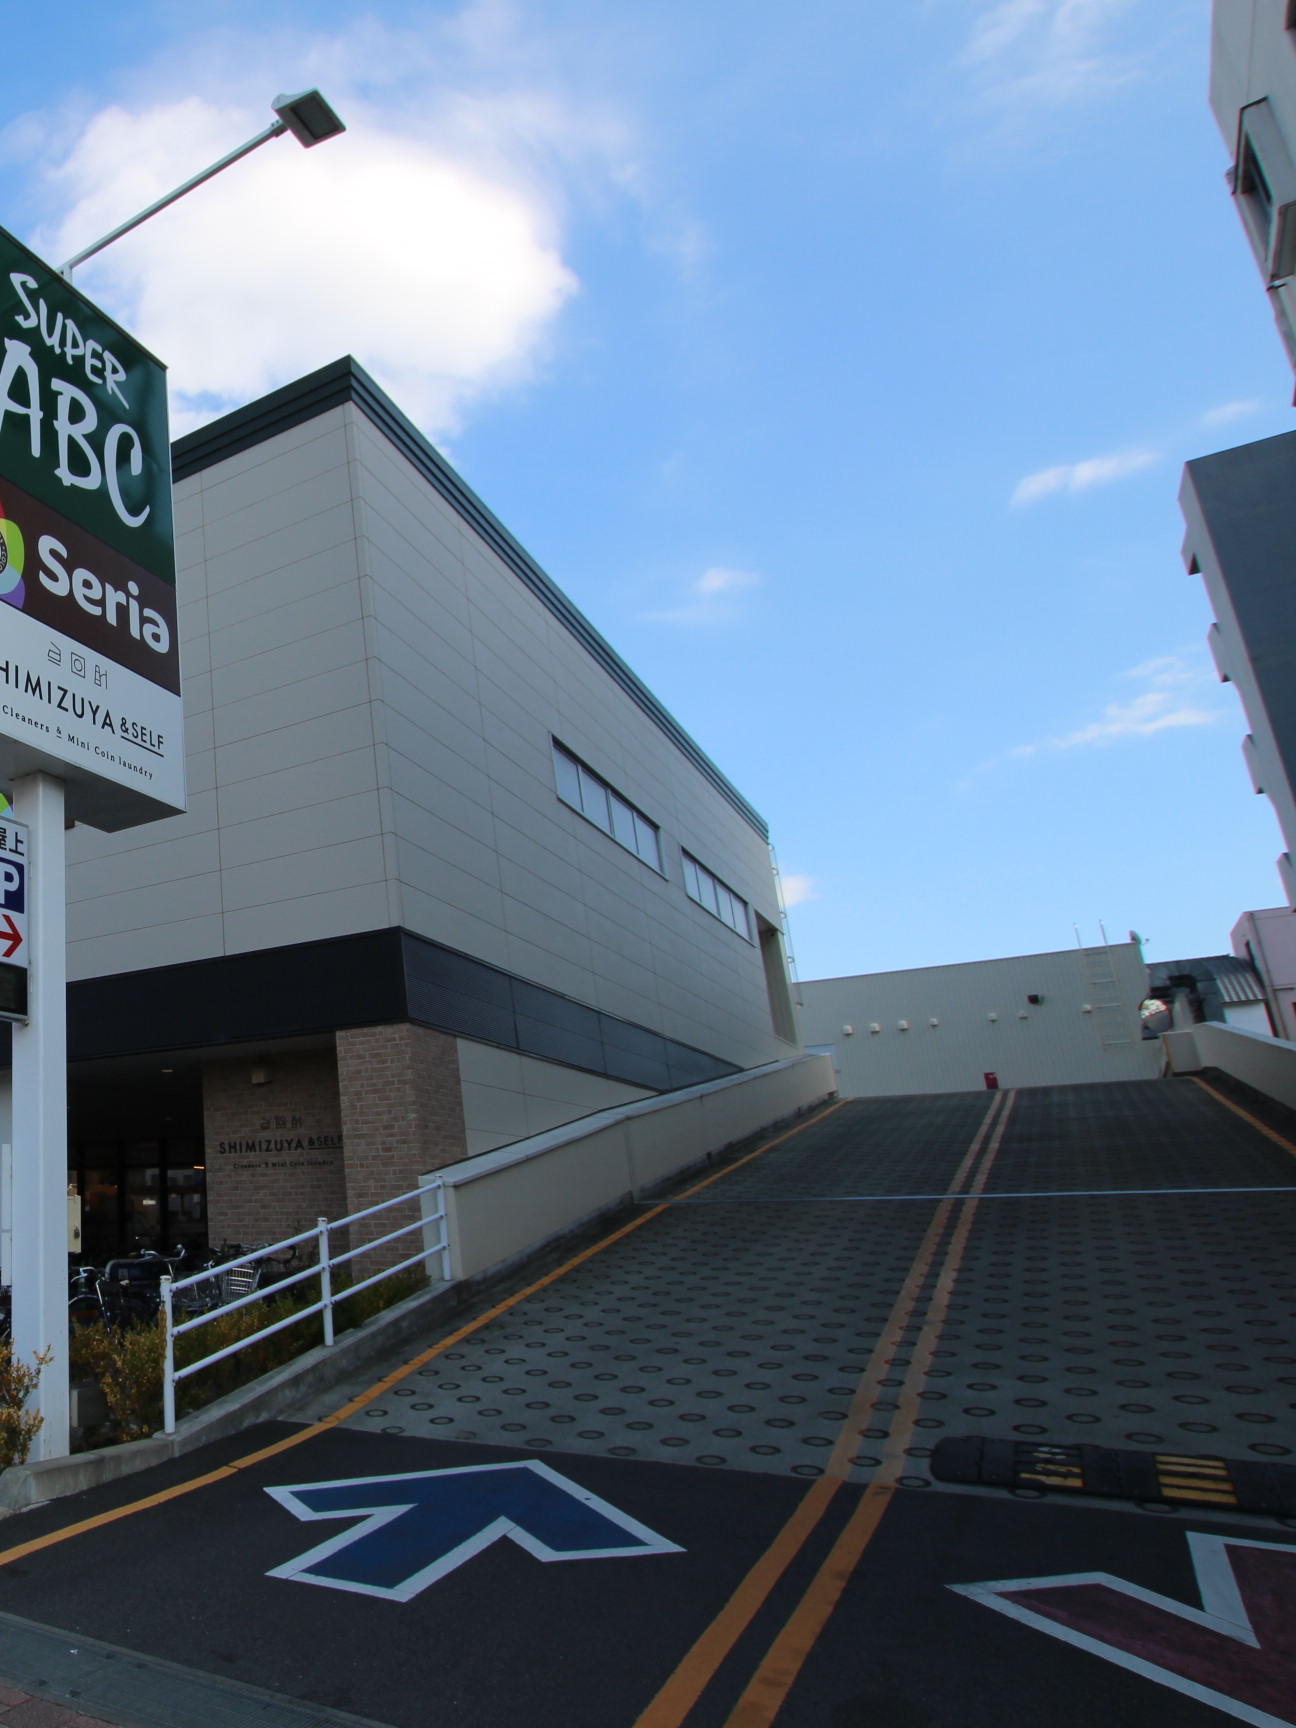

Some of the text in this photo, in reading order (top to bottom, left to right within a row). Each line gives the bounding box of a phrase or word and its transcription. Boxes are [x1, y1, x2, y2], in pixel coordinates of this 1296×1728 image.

[9, 272, 129, 410] SUPER
[37, 534, 170, 655] Seria
[2, 704, 51, 733] Cleaners
[67, 732, 91, 751] Mini
[94, 746, 116, 763] Coin
[118, 756, 154, 780] laundry
[120, 716, 164, 751] &SELF
[219, 1138, 305, 1155] SHIMIZUYA
